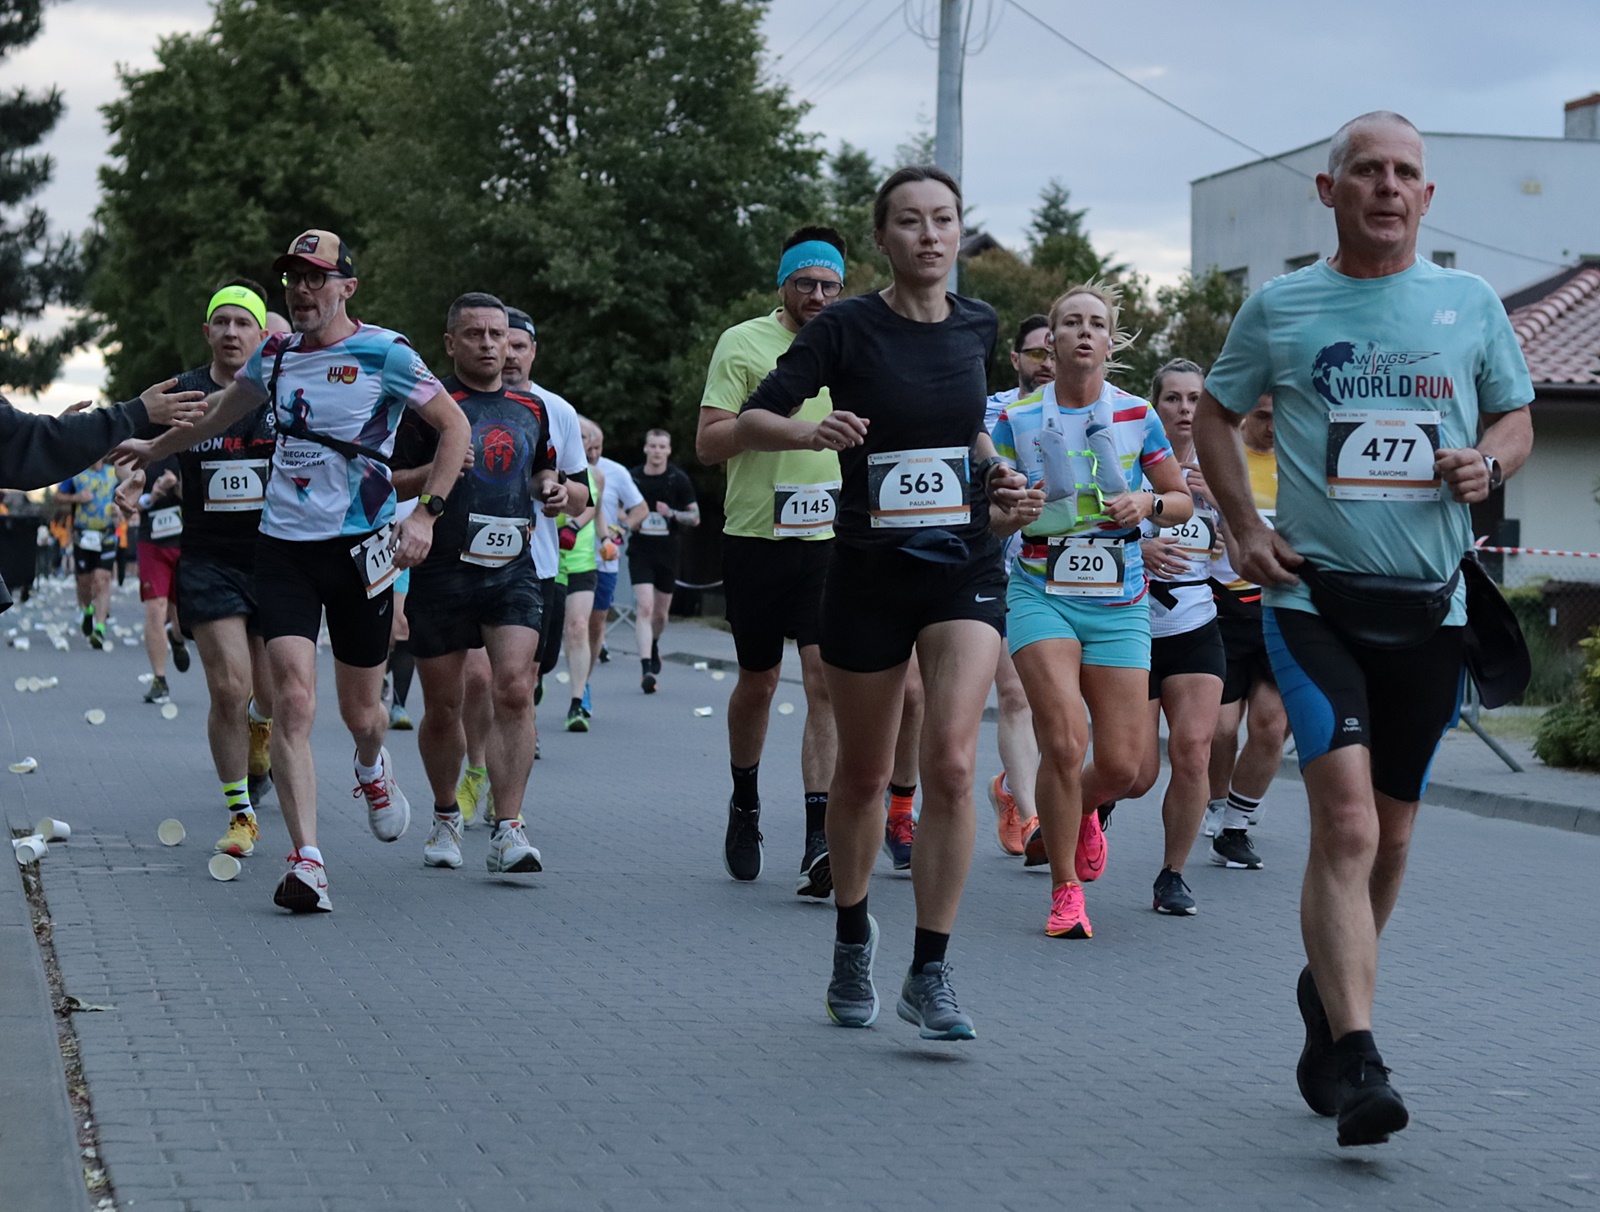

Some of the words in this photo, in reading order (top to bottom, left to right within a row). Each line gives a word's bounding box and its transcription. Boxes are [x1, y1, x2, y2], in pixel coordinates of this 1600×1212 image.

[1354, 352, 1408, 365] WINGS
[1362, 364, 1391, 376] LIFE
[1336, 375, 1412, 400] WORLD
[1415, 375, 1454, 399] RUN
[283, 450, 322, 459] BIEGACZE
[1361, 437, 1417, 462] 477
[1368, 469, 1408, 477] SŁAWOMIR
[220, 475, 248, 490] 181
[899, 471, 944, 495] 563
[791, 498, 829, 515] 1145
[1171, 524, 1199, 538] 562
[486, 532, 513, 547] 551
[1068, 555, 1104, 572] 520
